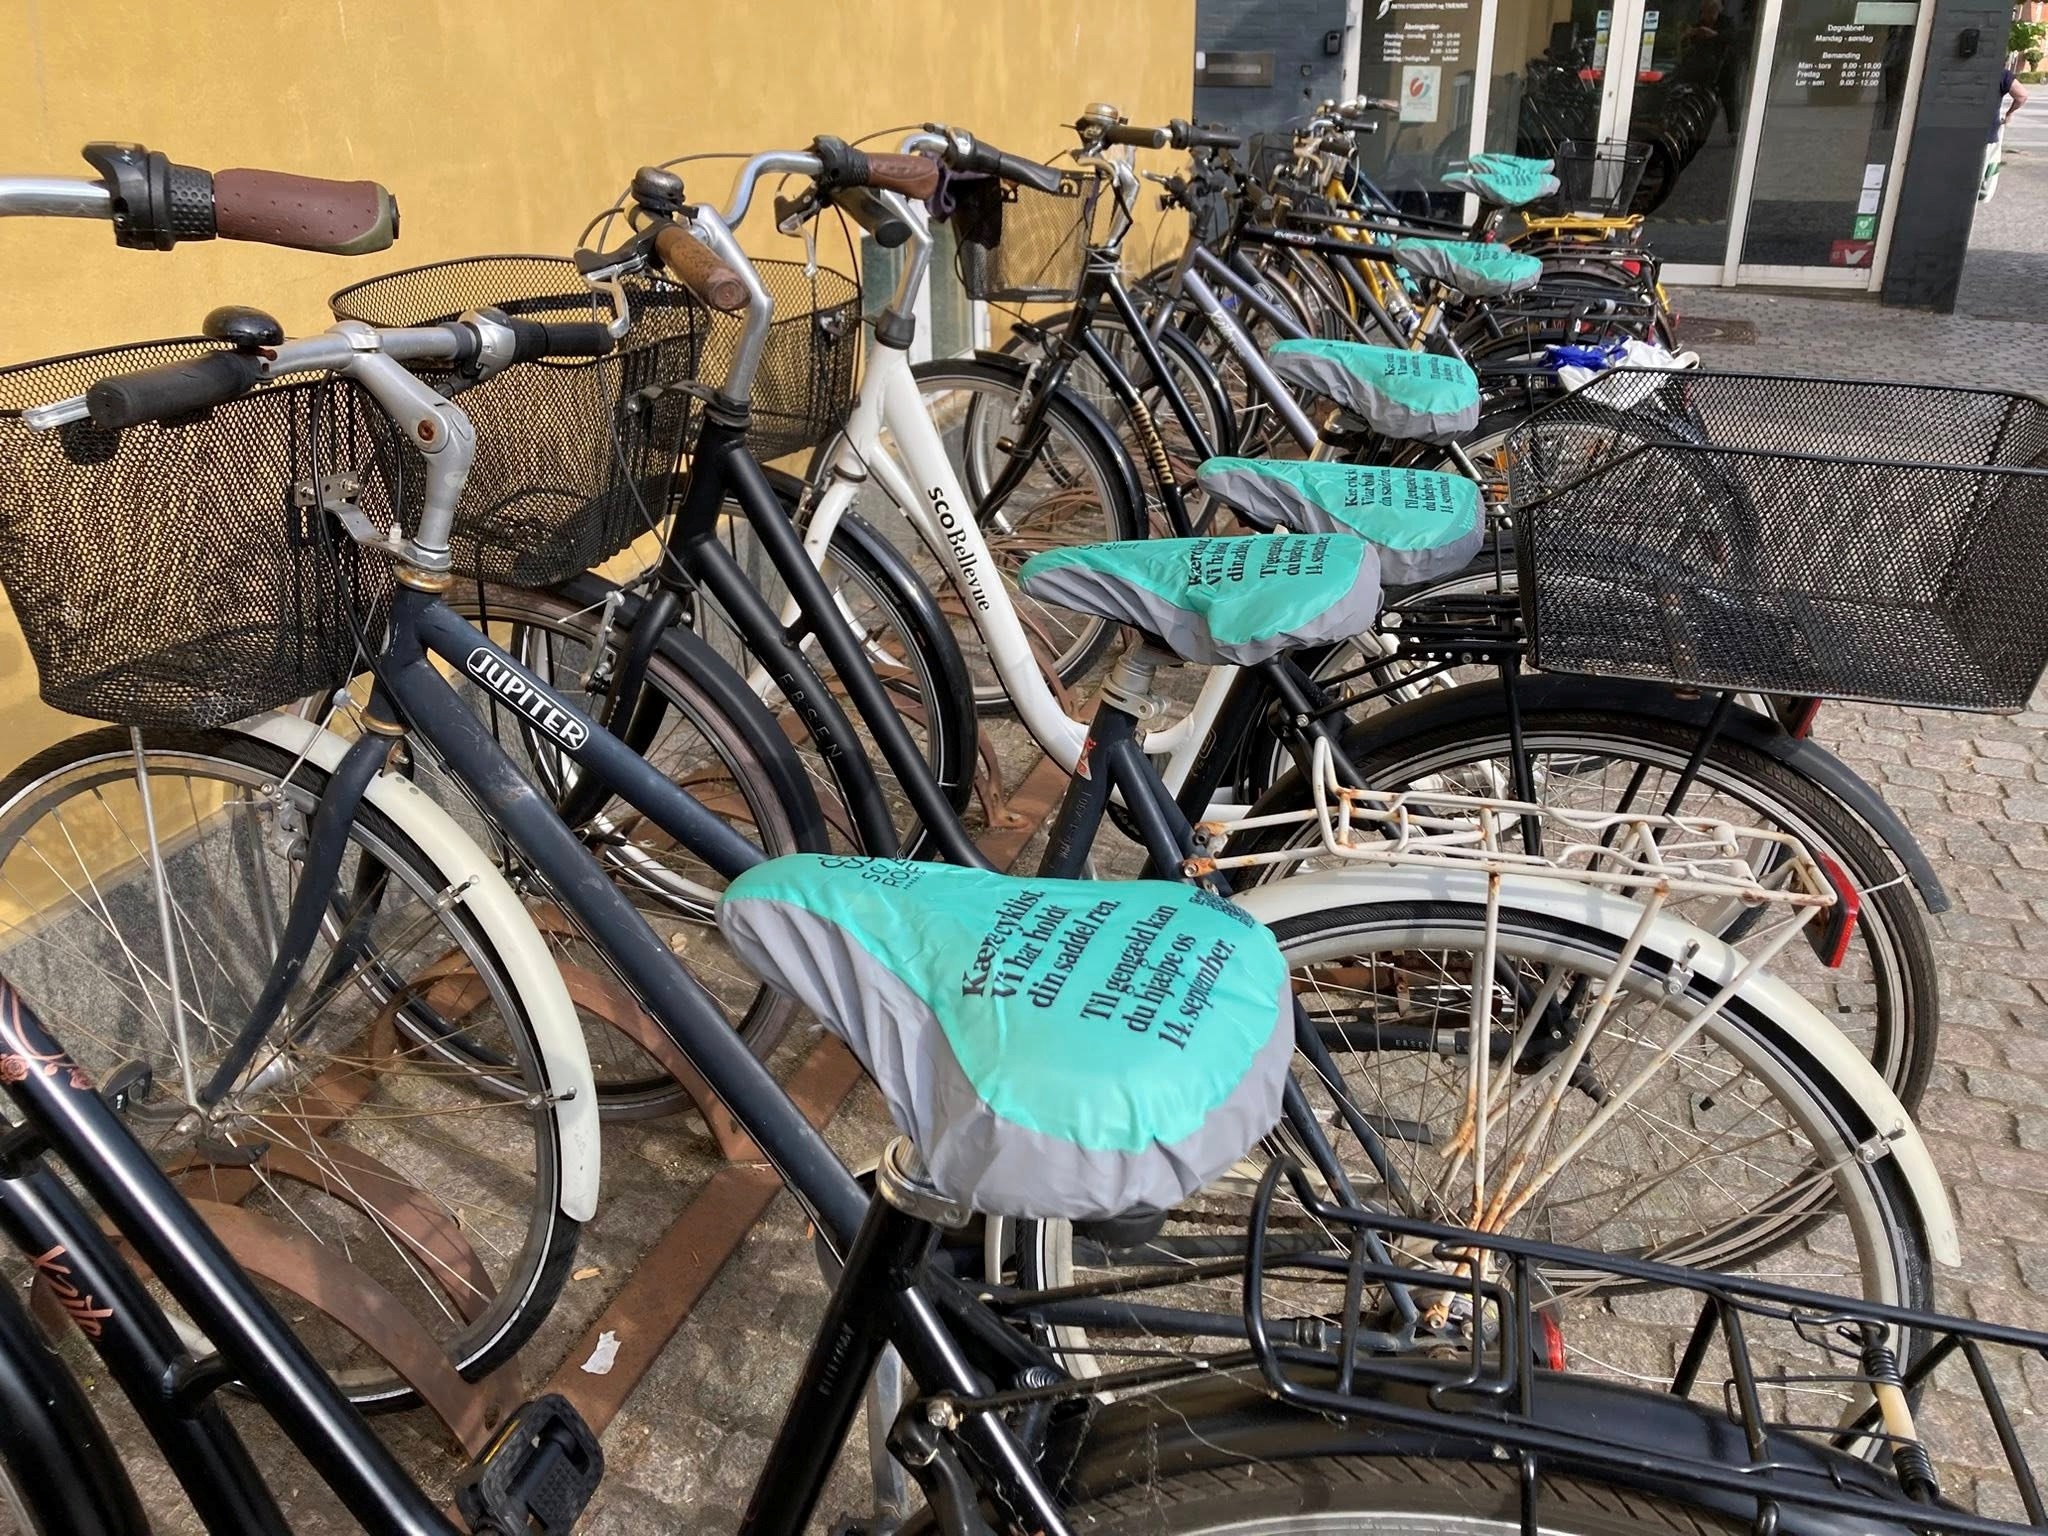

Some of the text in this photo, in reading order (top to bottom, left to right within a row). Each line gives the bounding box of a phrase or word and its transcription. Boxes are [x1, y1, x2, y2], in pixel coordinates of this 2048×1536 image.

[1815, 35, 1843, 43] Mandag
[1822, 52, 1861, 60] Bemanding
[1828, 24, 1865, 32] Døgnåbnet
[1797, 71, 1821, 79] Fredag
[469, 654, 584, 747] JUPITER
[962, 932, 1006, 997] Kære
[990, 904, 1072, 998] Vi har holdt
[1027, 972, 1067, 1008] din
[1053, 919, 1099, 973] saddel
[1080, 905, 1178, 1020] Til gengæld kan
[1121, 933, 1196, 1033] du hjælpe os
[1158, 938, 1236, 1050] 14. september.
